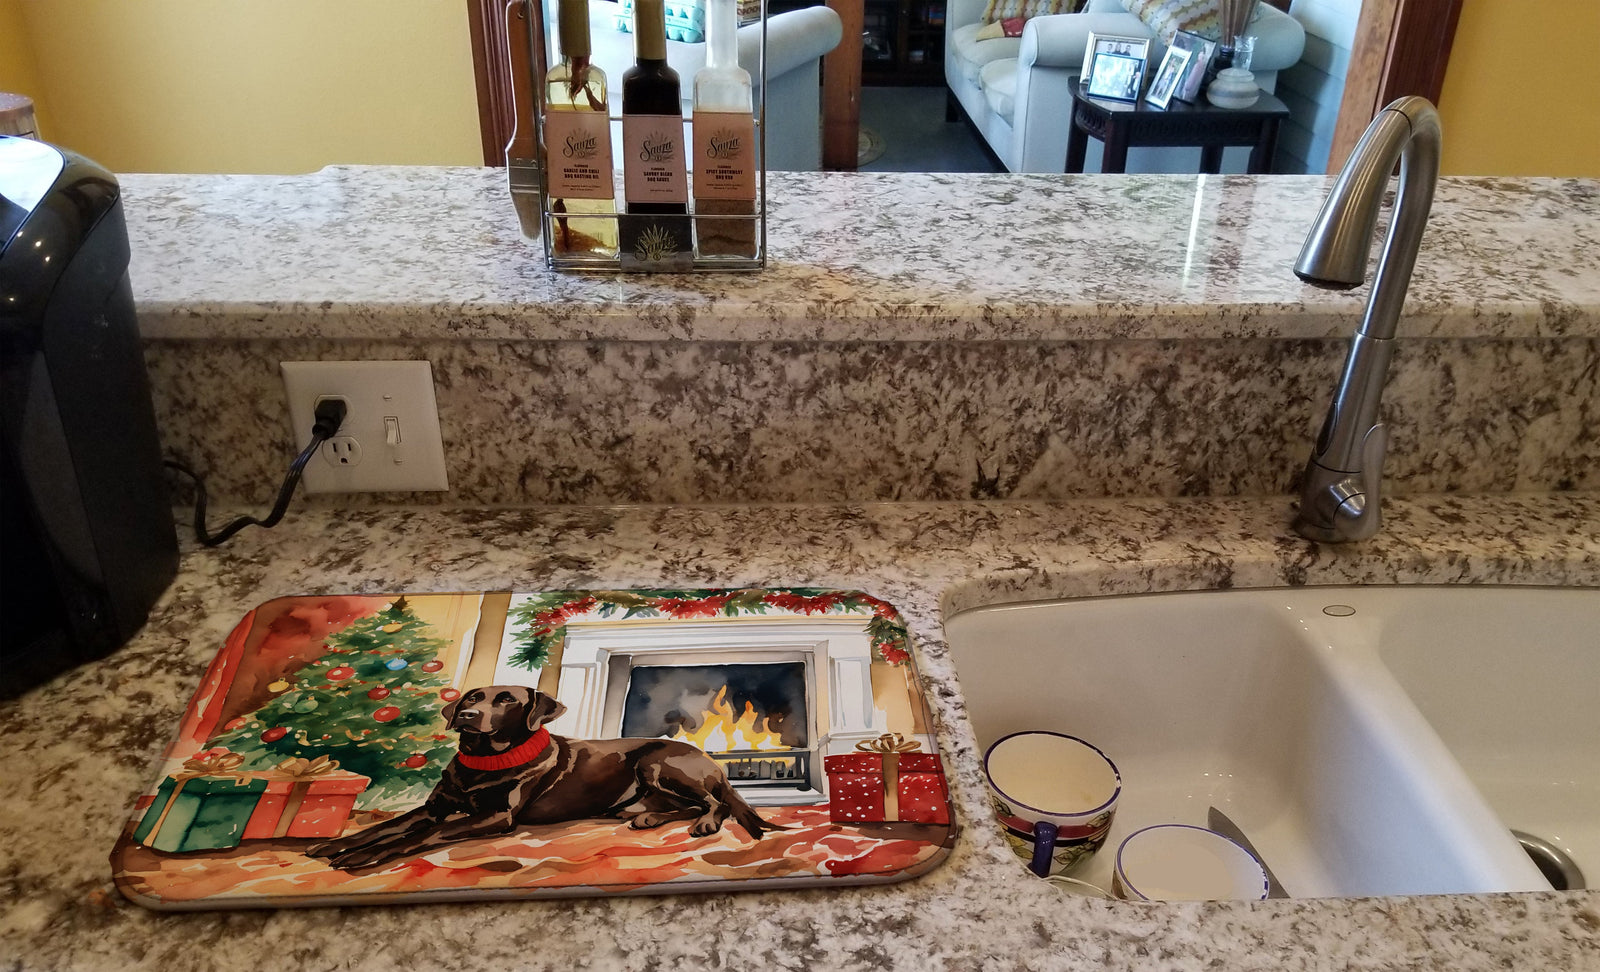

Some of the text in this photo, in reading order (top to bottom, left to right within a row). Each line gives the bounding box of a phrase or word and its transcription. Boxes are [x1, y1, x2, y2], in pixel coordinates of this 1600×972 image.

[562, 136, 598, 158] Sauza
[640, 140, 673, 161] Sauza
[706, 136, 740, 159] Sauza
